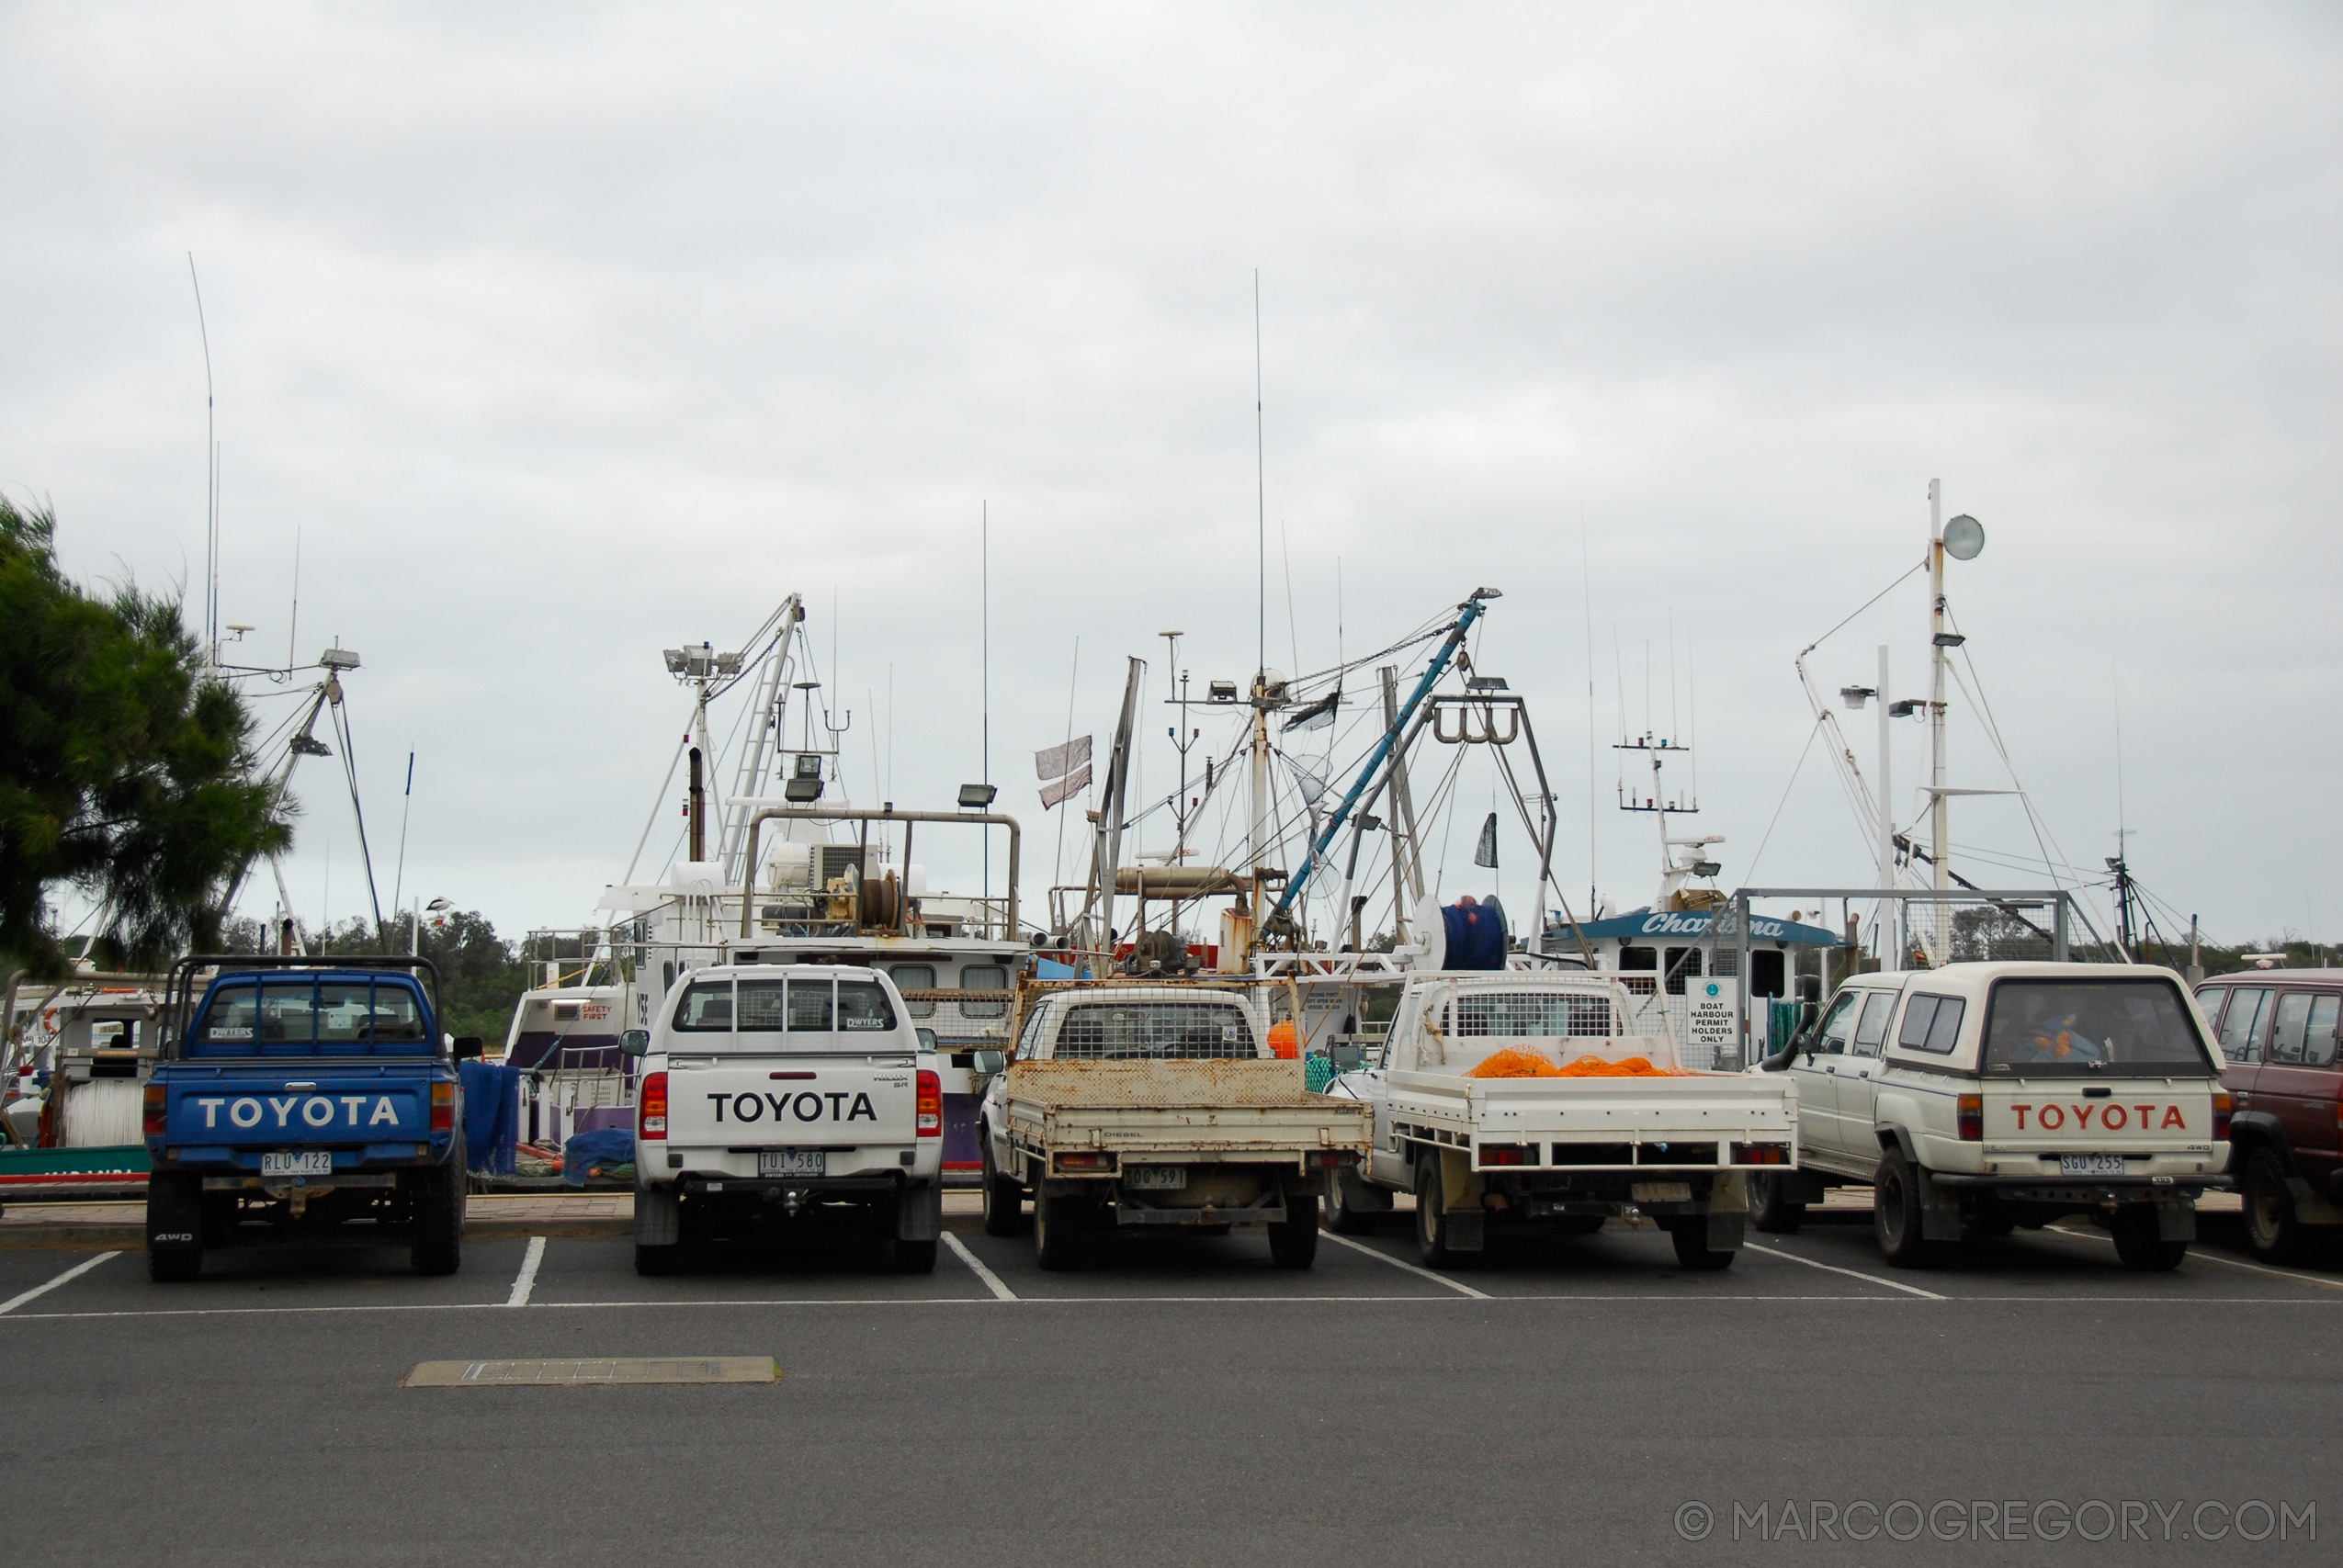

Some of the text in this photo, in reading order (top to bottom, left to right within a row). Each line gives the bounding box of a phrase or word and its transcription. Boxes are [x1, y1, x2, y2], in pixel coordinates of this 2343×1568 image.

[846, 1018, 885, 1028] DWYERS
[209, 1027, 254, 1039] DWYERS
[874, 1074, 908, 1082] HILUX
[198, 1097, 400, 1128] TOYOTA
[707, 1092, 877, 1122] TOYOTA
[2010, 1104, 2186, 1130] TOYOTA
[265, 1154, 330, 1170] RLU 122
[762, 1154, 822, 1168] TUI 580
[2063, 1155, 2121, 1169] SGU 255
[1160, 1168, 1183, 1183] 591
